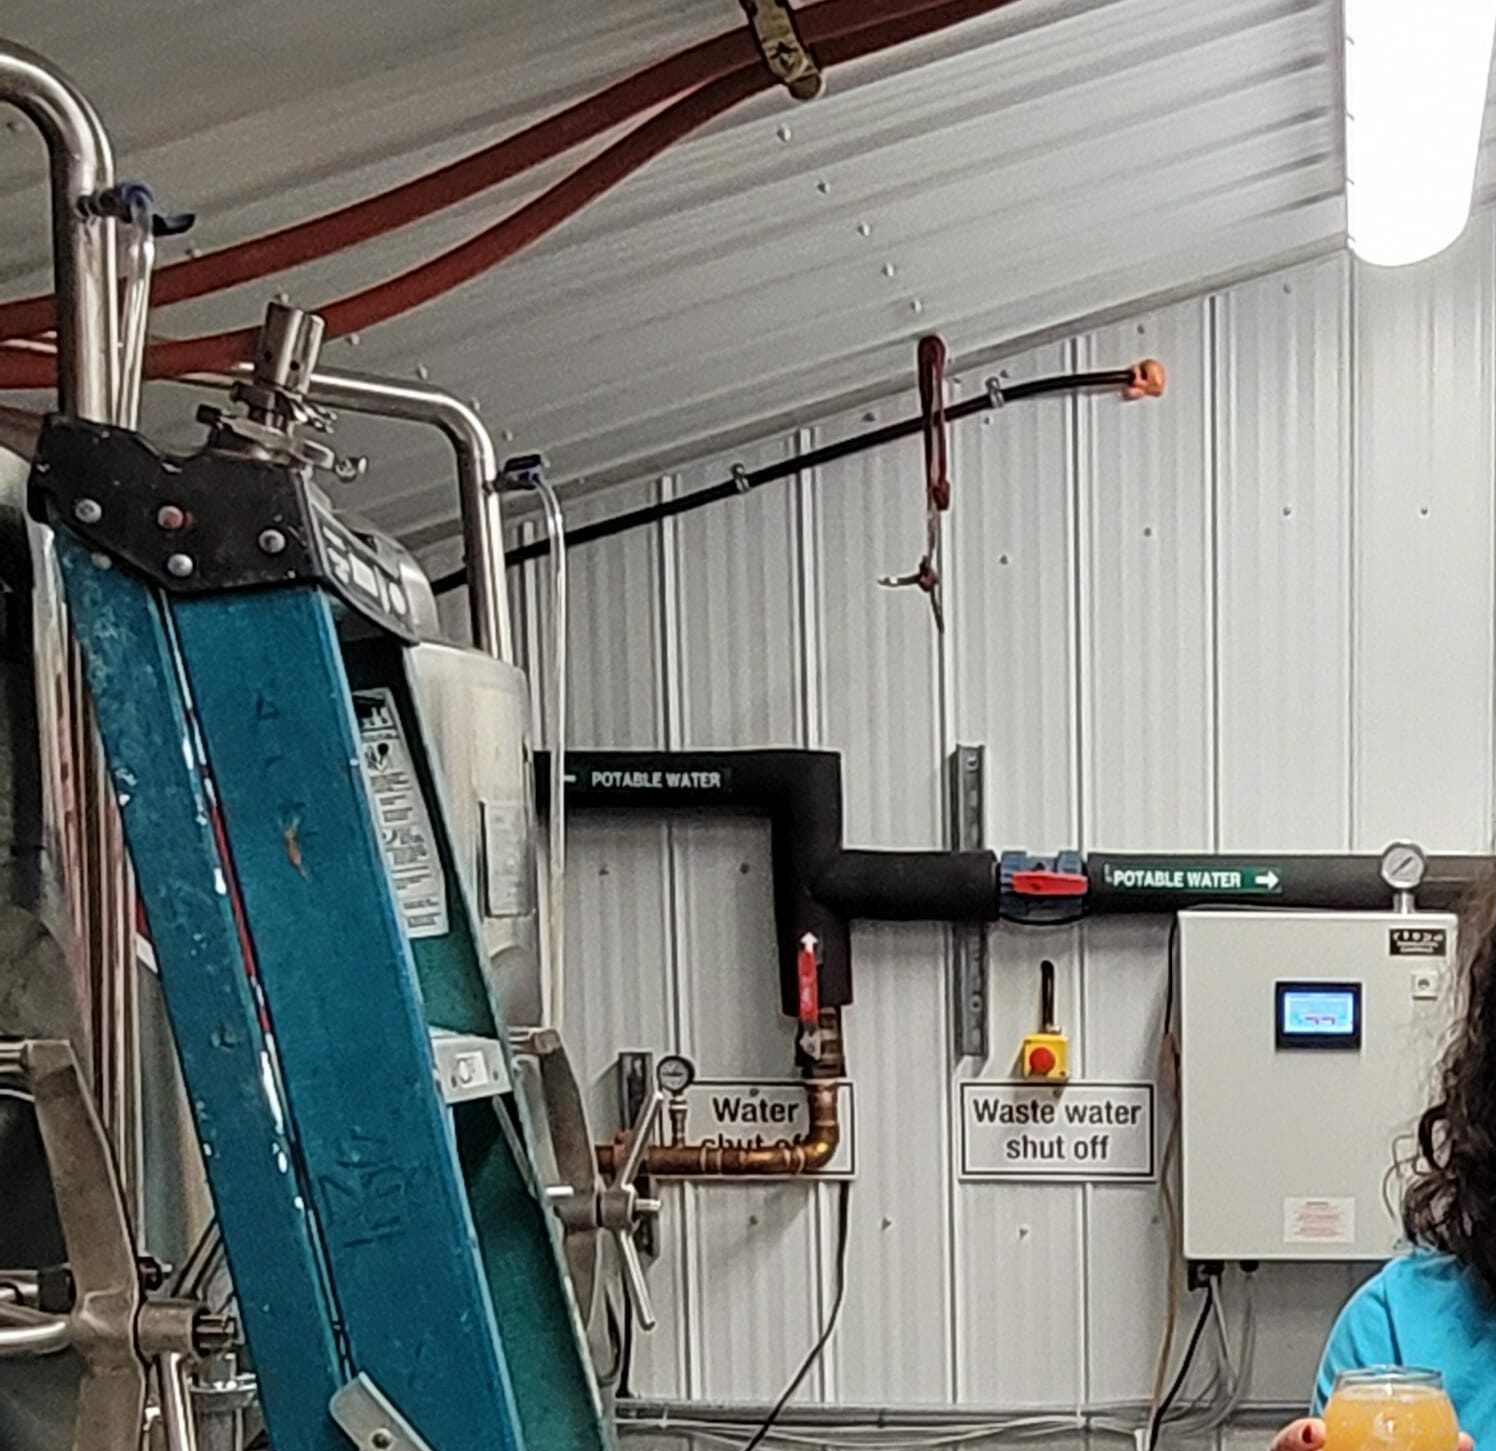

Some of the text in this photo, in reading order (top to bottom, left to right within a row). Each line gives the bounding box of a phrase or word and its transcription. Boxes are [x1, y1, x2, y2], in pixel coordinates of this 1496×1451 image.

[591, 771, 721, 788] POTABLE WATER
[1113, 870, 1241, 888] POTABLE WATER
[712, 1097, 799, 1123] Water
[973, 1098, 1142, 1125] Waste water
[1006, 1134, 1109, 1160] shut off
